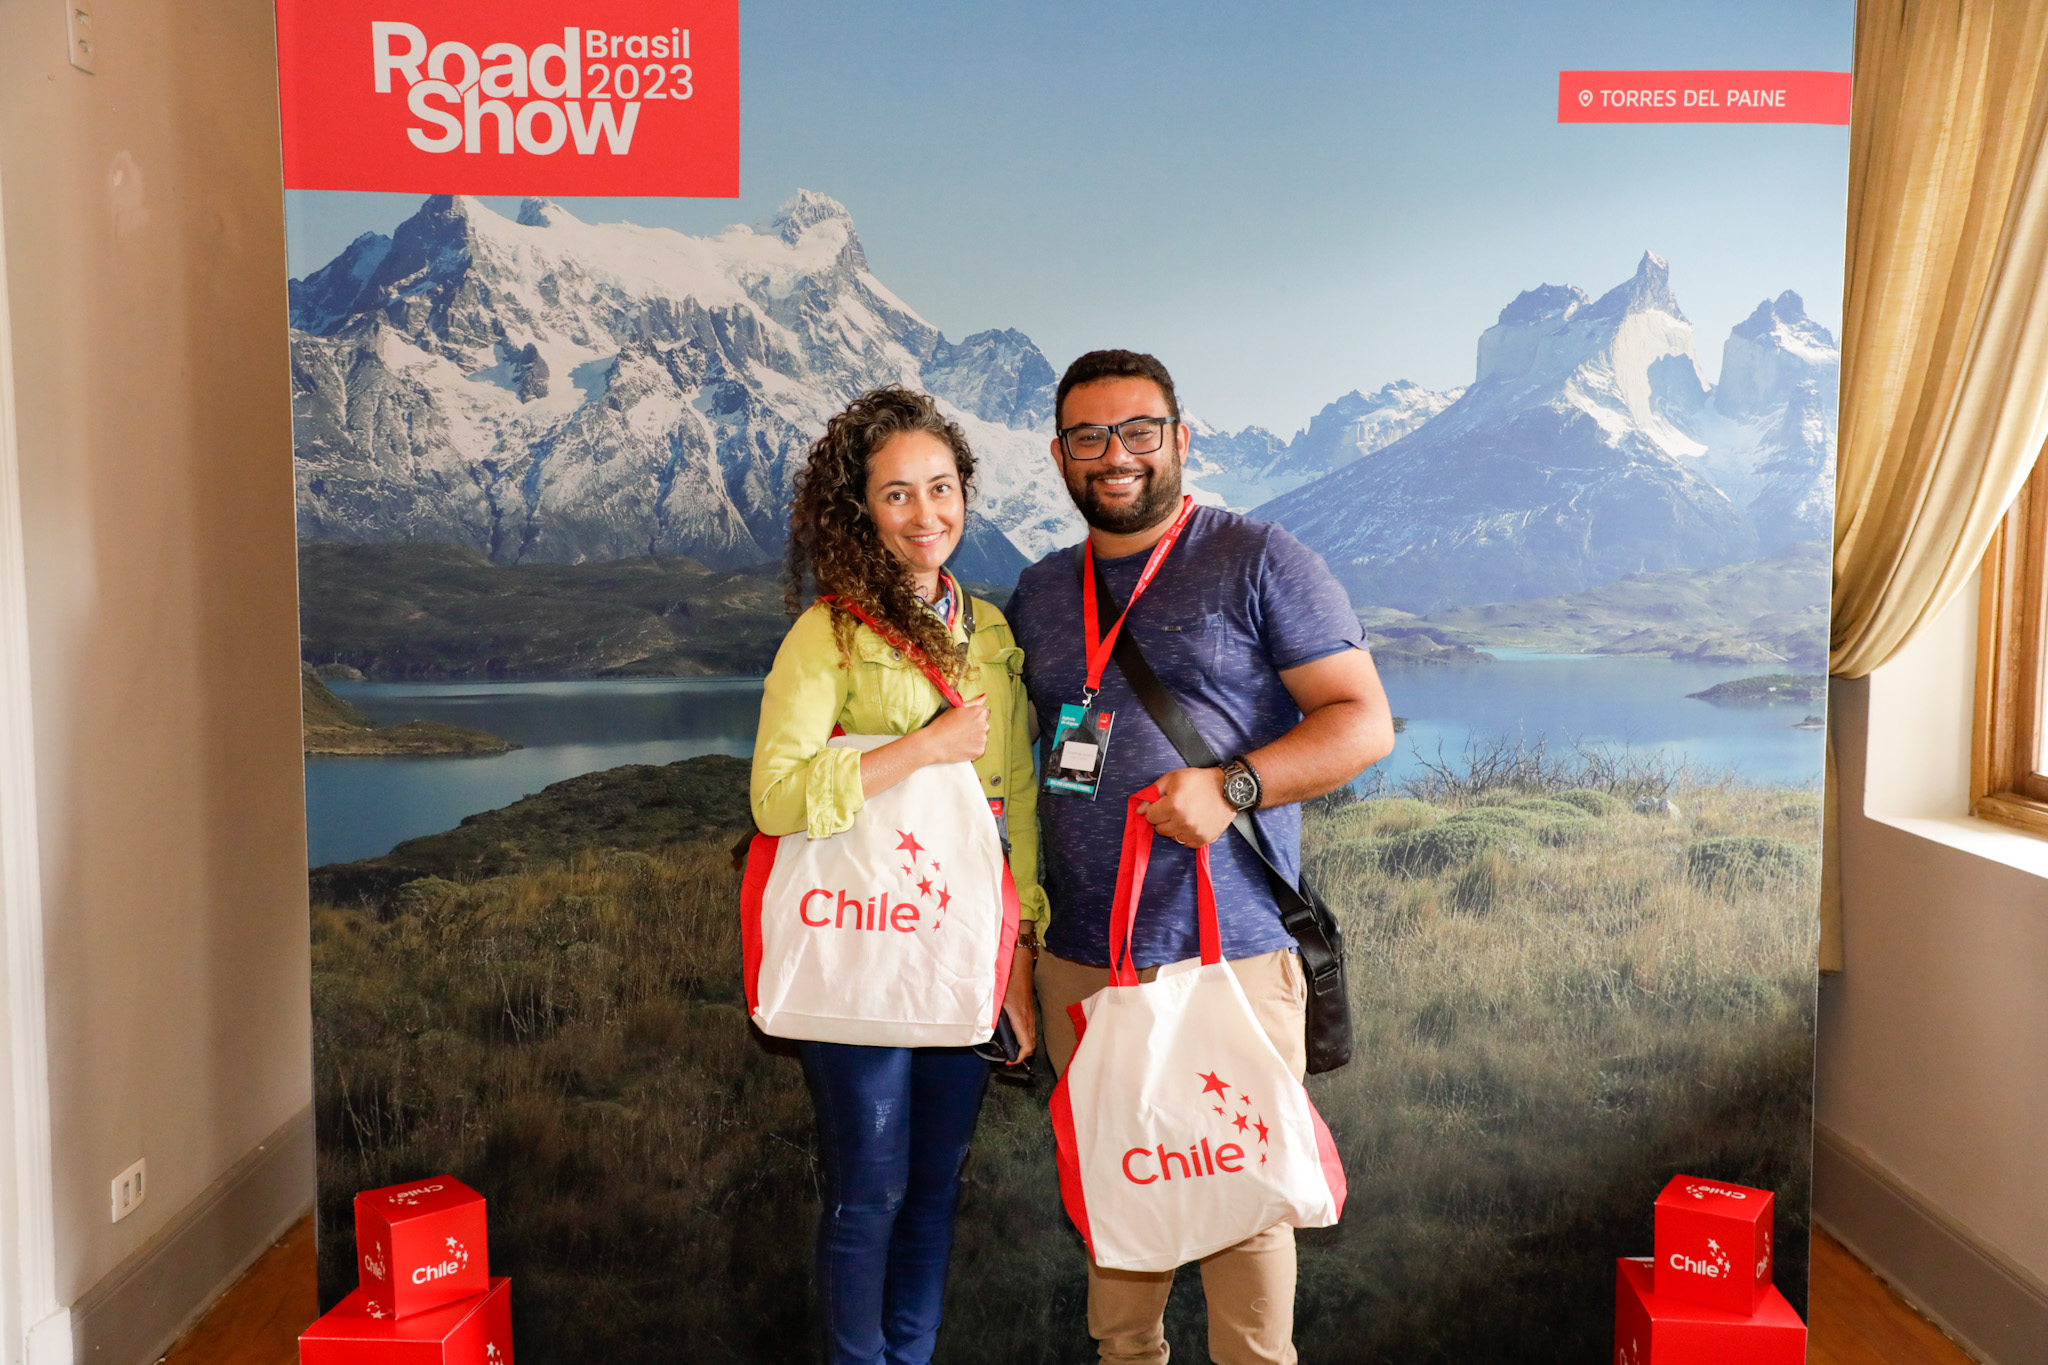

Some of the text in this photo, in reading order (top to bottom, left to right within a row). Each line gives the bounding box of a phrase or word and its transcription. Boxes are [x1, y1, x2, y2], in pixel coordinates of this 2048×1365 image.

[586, 27, 690, 59] Brasil
[371, 21, 581, 98] Road
[587, 63, 693, 100] 2023
[1600, 89, 1786, 107] TORRES DEL PAINE
[406, 79, 642, 155] Show
[1144, 539, 1172, 581] www.chile.travel
[799, 888, 920, 934] Chile
[1122, 1137, 1245, 1185] Chile
[397, 1184, 444, 1199] Chile
[1698, 1185, 1747, 1201] Chile
[364, 1254, 382, 1279] Chile
[411, 1260, 459, 1285] Chile
[1669, 1253, 1720, 1278] Chile
